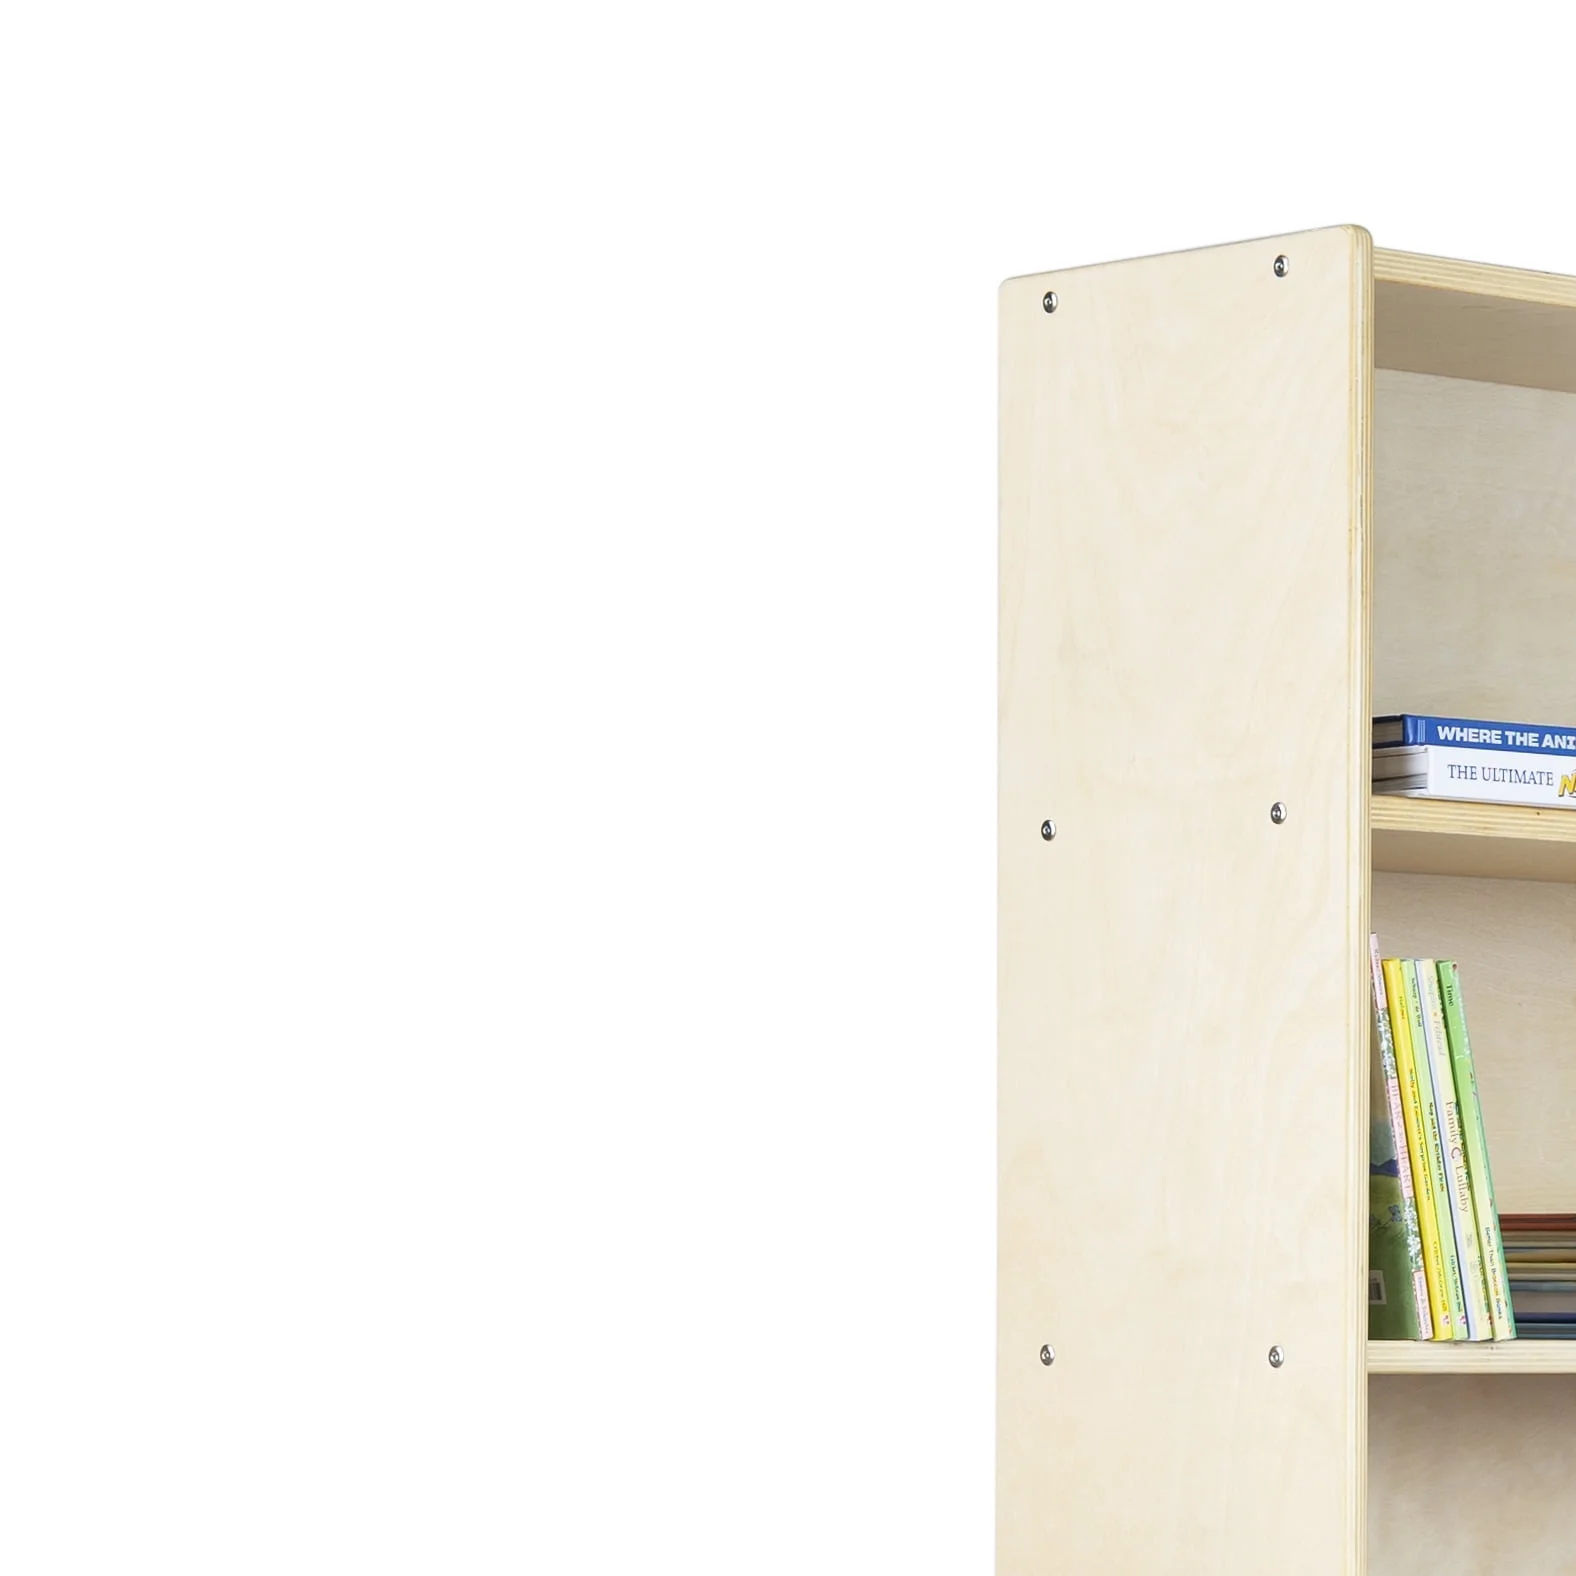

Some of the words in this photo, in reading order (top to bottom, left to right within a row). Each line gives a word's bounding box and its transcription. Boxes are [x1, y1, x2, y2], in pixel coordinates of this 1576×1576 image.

[1437, 726, 1502, 745] WHERE
[1505, 731, 1539, 747] THE
[1447, 764, 1477, 780] THE
[1481, 767, 1555, 786] ULTIMATE
[1446, 985, 1454, 1006] Time
[1446, 1101, 1457, 1144] Family
[1456, 1166, 1469, 1212] Lullaby
